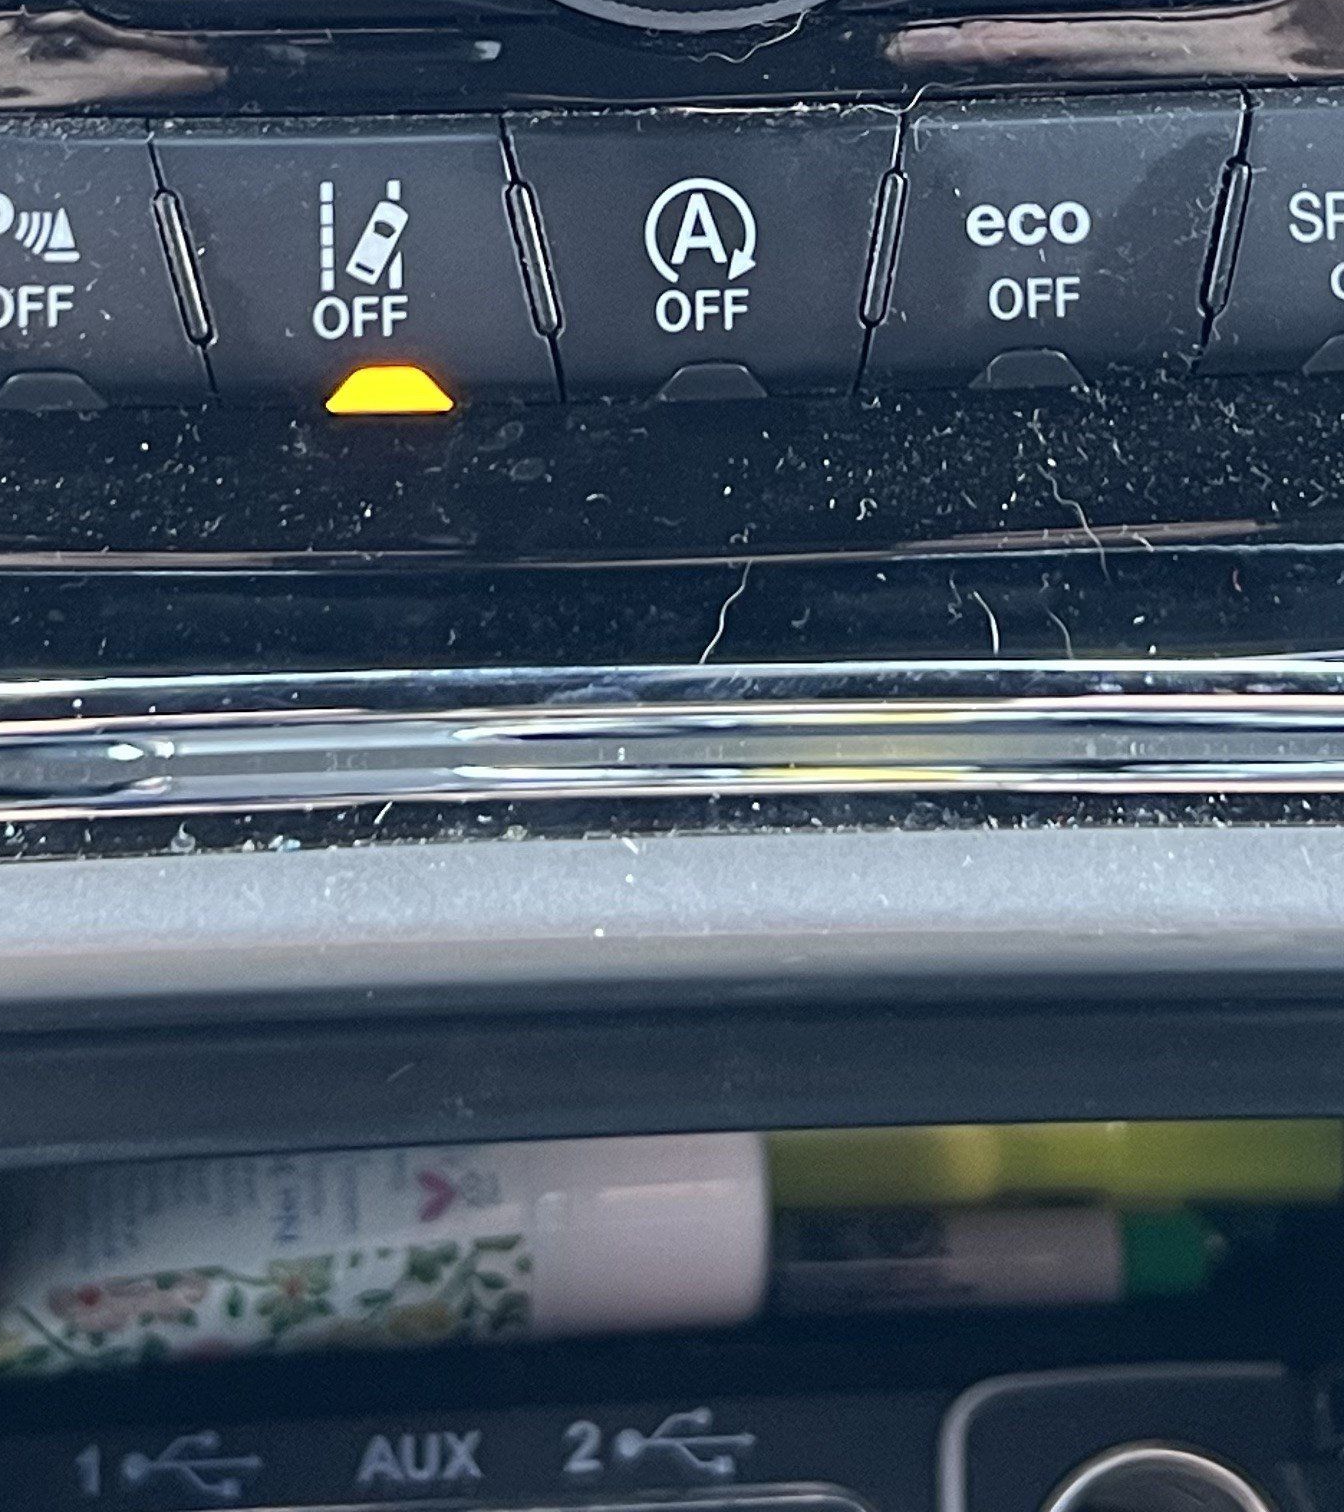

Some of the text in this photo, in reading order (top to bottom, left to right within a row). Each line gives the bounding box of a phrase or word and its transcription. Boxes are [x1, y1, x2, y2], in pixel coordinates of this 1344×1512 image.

[965, 201, 1091, 247] eco
[312, 294, 409, 340] OFF
[655, 288, 750, 333] OFF
[988, 277, 1081, 321] OFF
[356, 1429, 484, 1484] AUX
[564, 1420, 602, 1474] 2
